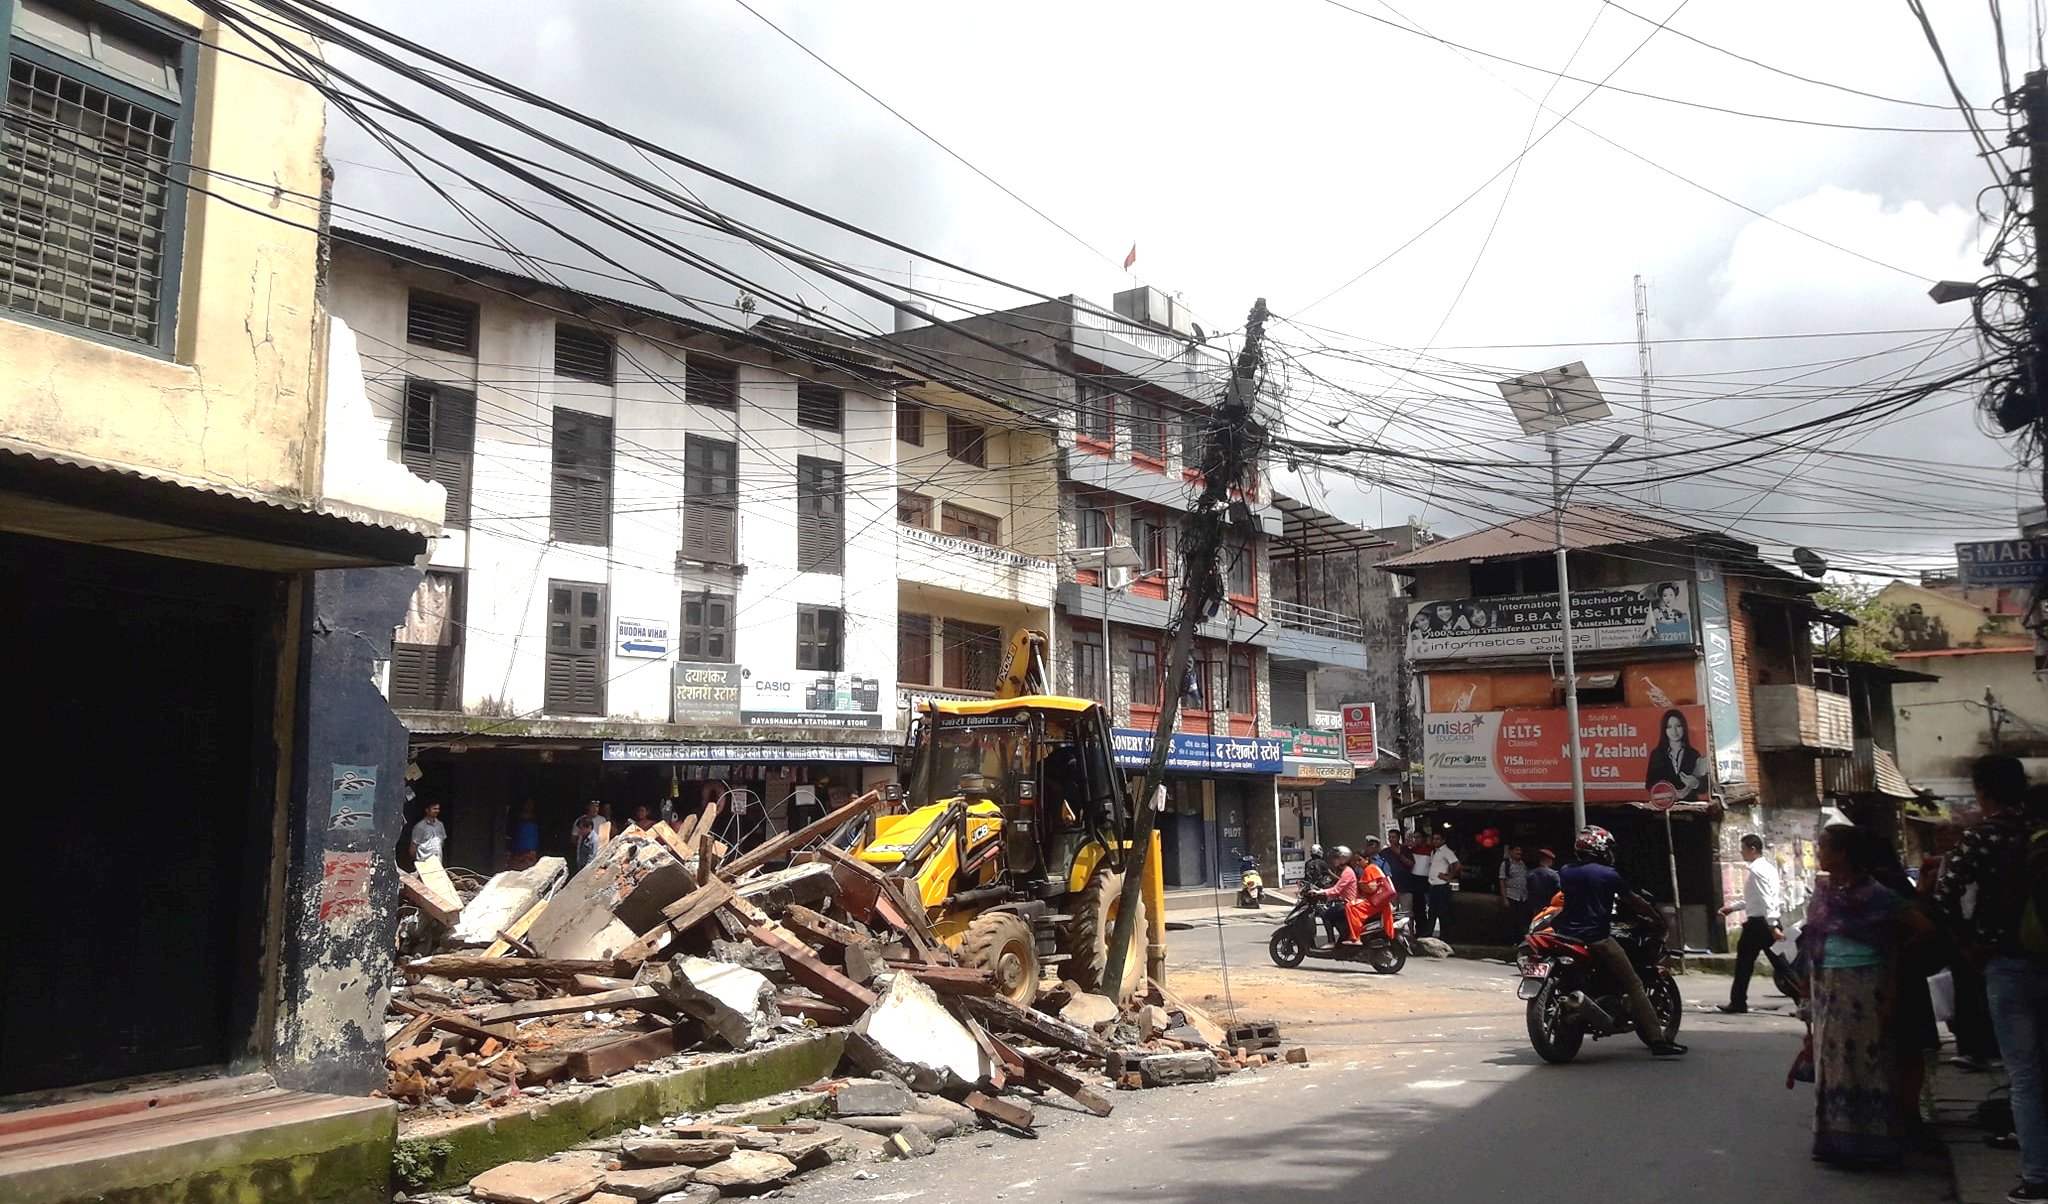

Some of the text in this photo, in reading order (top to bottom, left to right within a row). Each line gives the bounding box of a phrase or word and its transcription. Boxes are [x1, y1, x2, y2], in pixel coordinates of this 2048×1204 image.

[1610, 606, 1624, 616] IT
[619, 626, 668, 639] BUDDHA VIHAR
[1431, 638, 1525, 651] informatics
[755, 681, 791, 692] CASIO
[751, 717, 802, 725] DAYASHANKAR
[804, 718, 845, 726] STATIONERY
[1428, 721, 1476, 735] unistar
[1503, 725, 1542, 739] IELTS
[1579, 723, 1637, 738] ustralia
[1216, 743, 1224, 759] द
[1561, 743, 1648, 758] Nw Zealand
[1503, 756, 1524, 766] VISA
[1591, 766, 1620, 777] USA
[971, 824, 989, 843] JCB
